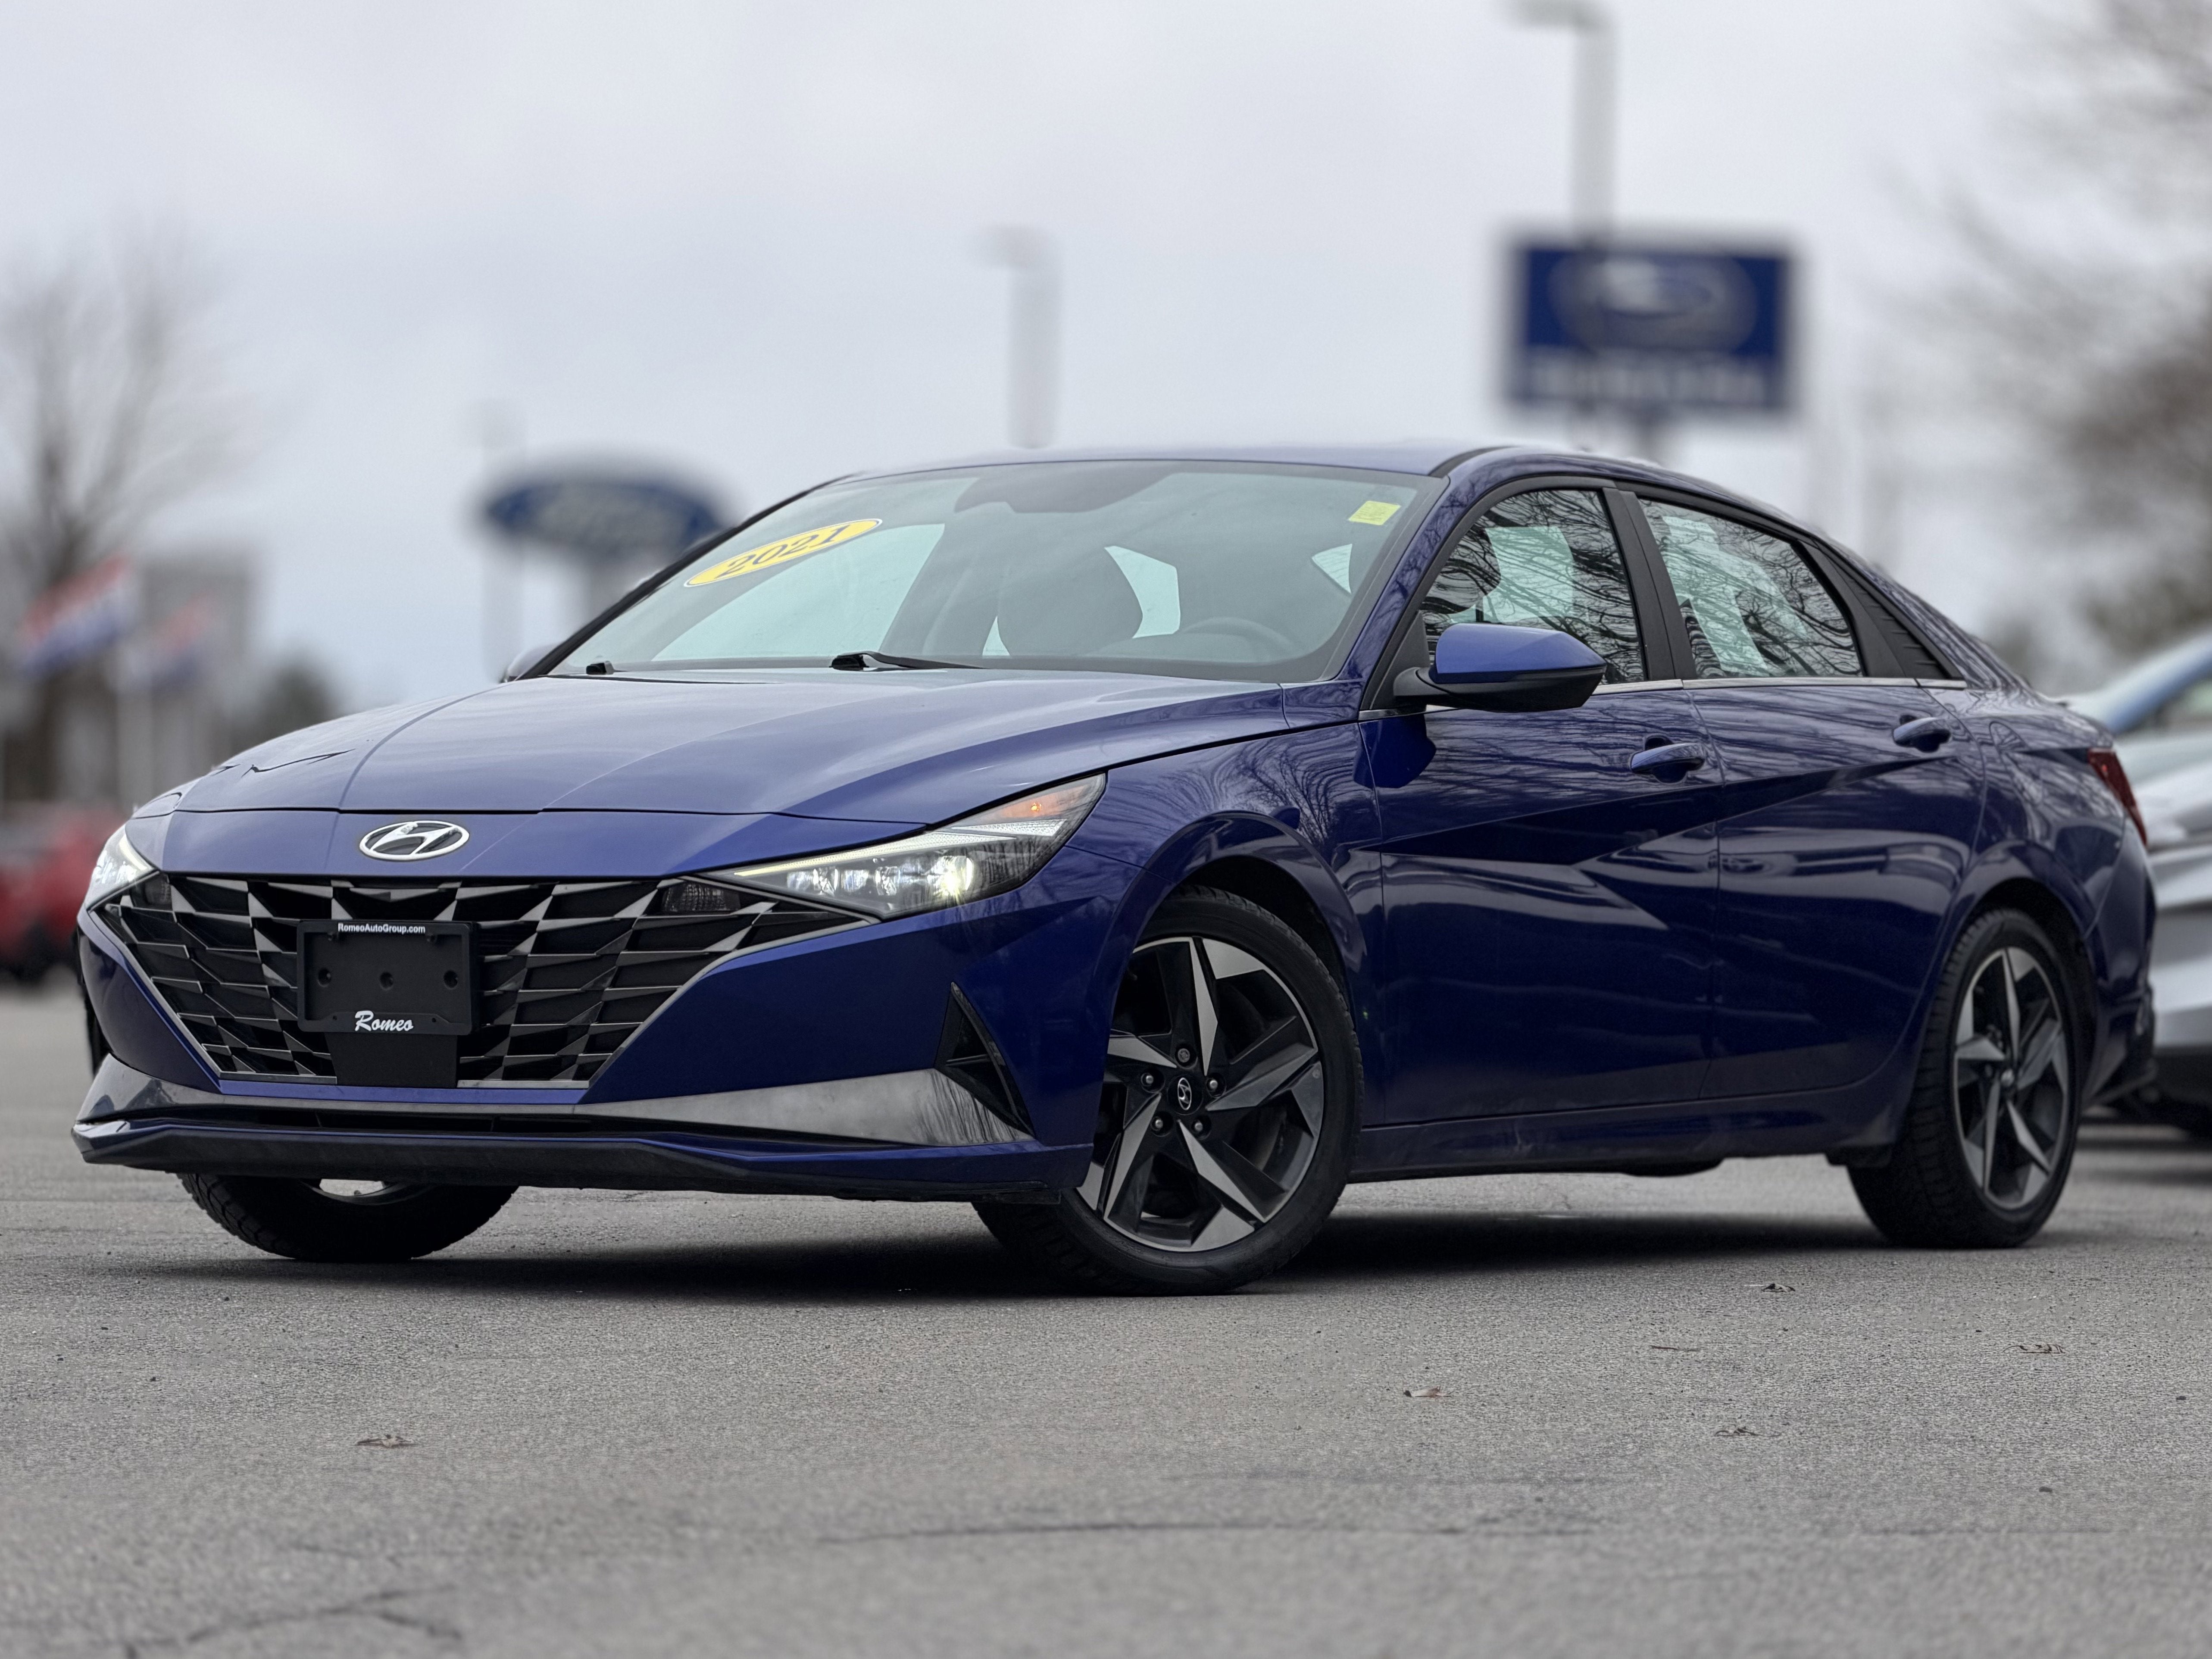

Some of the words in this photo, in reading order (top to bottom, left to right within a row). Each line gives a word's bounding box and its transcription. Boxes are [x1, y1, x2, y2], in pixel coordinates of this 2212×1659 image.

[715, 524, 852, 579] 2021
[337, 923, 426, 934] RomeoAutoGroup.com
[354, 1010, 414, 1031] Romeo
